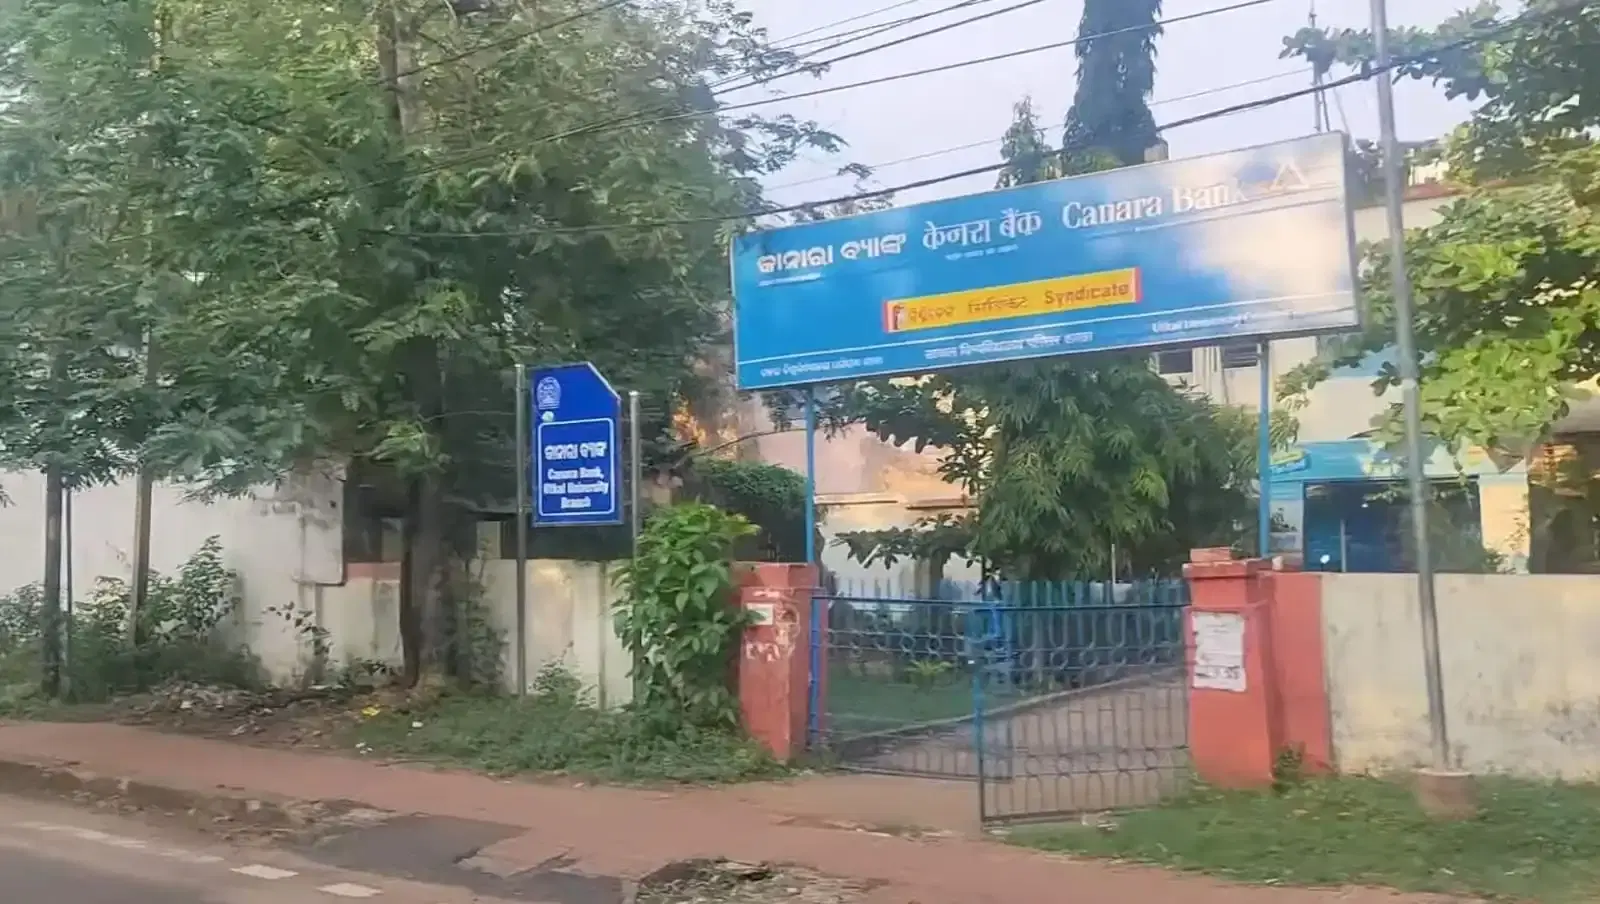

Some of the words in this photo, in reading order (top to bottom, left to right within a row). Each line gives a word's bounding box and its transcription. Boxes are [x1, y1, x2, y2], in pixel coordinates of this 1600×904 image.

[1062, 195, 1163, 230] Canara
[1171, 180, 1248, 214] Bank
[922, 220, 996, 250] केनरा
[999, 207, 1042, 239] बैंक
[1044, 281, 1130, 309] Syndicate
